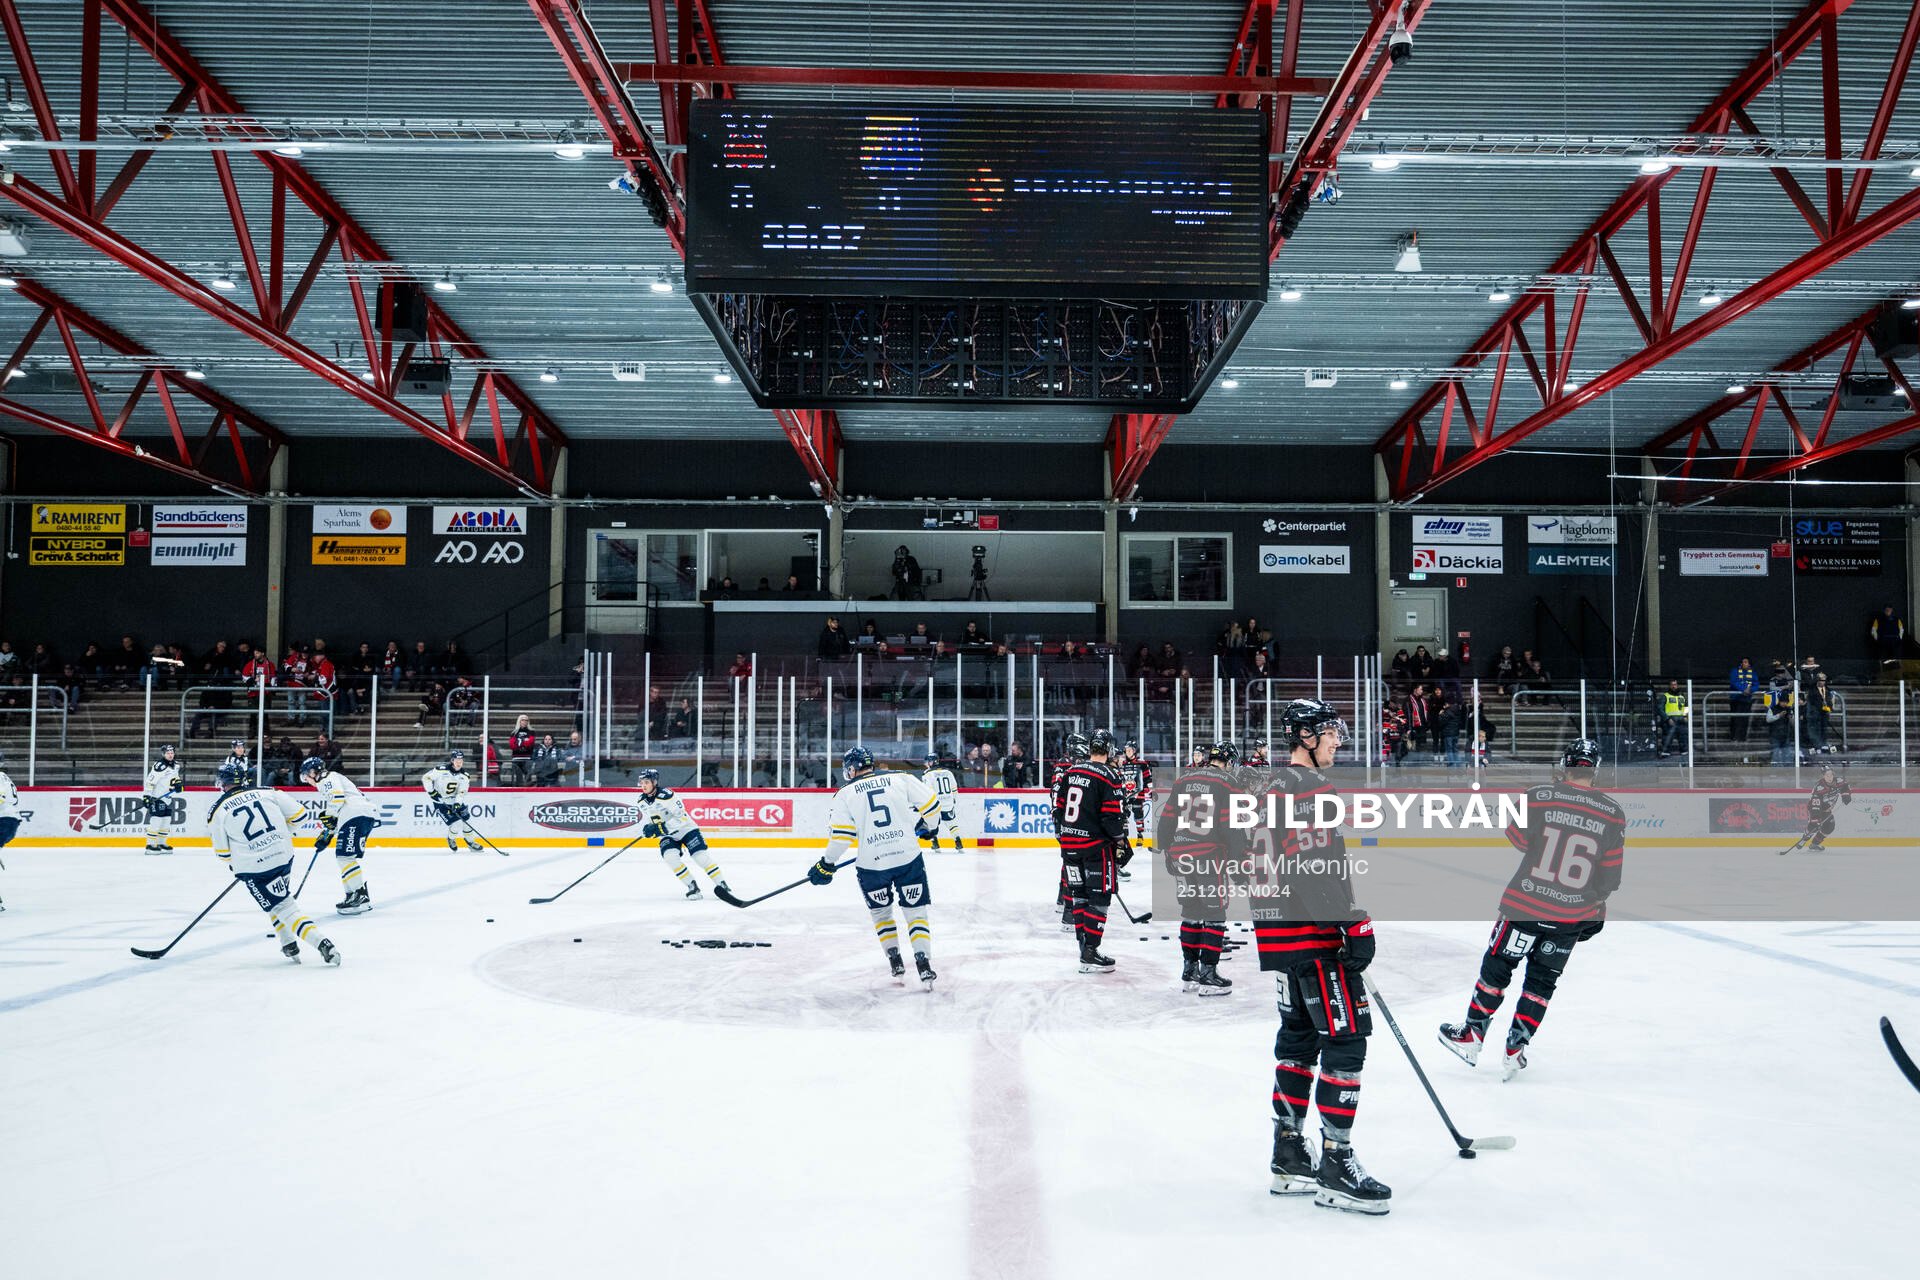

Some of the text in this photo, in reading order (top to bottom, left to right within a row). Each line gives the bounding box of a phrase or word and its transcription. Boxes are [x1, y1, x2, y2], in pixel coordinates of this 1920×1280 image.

[154, 510, 245, 523] Sandbäckens
[336, 505, 362, 518] Ålems
[51, 512, 122, 526] RAMIRENT
[323, 518, 361, 529] Sparbank
[1278, 521, 1347, 533] Centerpartiet
[1559, 523, 1616, 538] Hagbloms
[47, 539, 106, 550] NYBRO
[1278, 554, 1345, 566] amokabel
[1438, 555, 1502, 569] Däckia
[1536, 555, 1611, 567] ALEMTEK
[1713, 551, 1726, 559] och
[1811, 558, 1881, 566] KVARNSTRANDS
[936, 776, 952, 795] 10
[99, 797, 187, 825] NBB
[414, 804, 496, 818] EMON
[532, 805, 639, 816] KOLSBYGDS
[866, 788, 892, 828] 5
[1064, 786, 1083, 823] 8
[232, 800, 277, 842] 21
[532, 814, 640, 824] MASKINCENTER
[690, 807, 755, 821] CIRCLE
[1625, 814, 1665, 829] oria
[866, 829, 905, 846] MÅNSBRO
[1531, 826, 1598, 890] 16
[1253, 907, 1283, 920] STEEL
